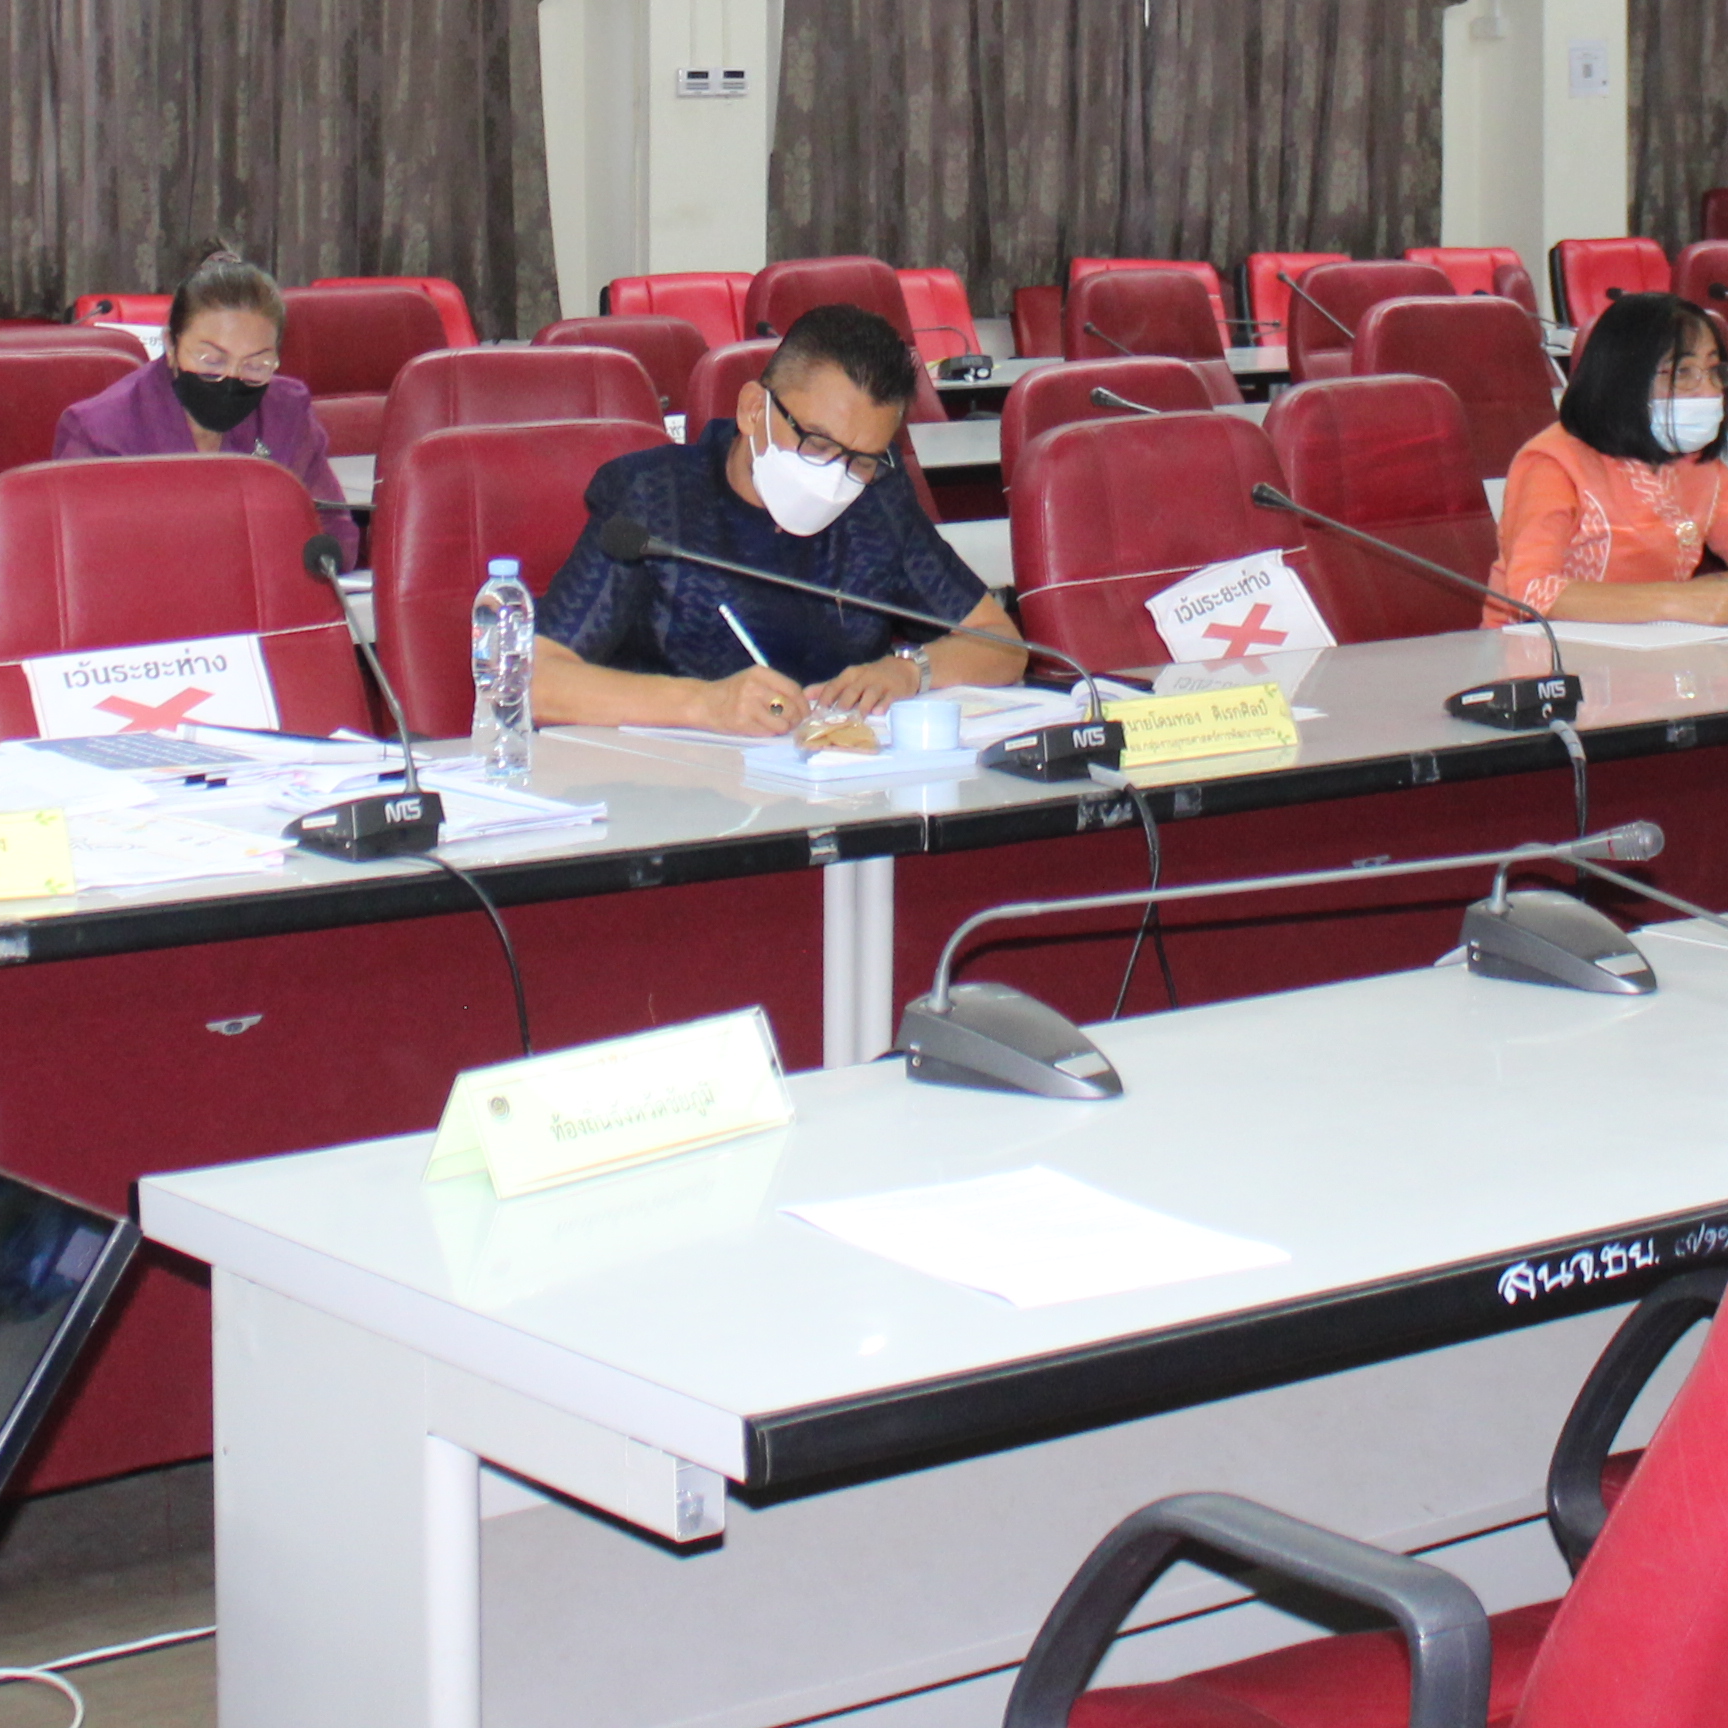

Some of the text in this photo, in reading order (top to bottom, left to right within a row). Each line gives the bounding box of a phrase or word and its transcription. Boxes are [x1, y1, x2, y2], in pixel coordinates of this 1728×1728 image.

[1174, 569, 1271, 625] เว้นระยะห่าง
[62, 648, 228, 690] เว้นระยะห่าง
